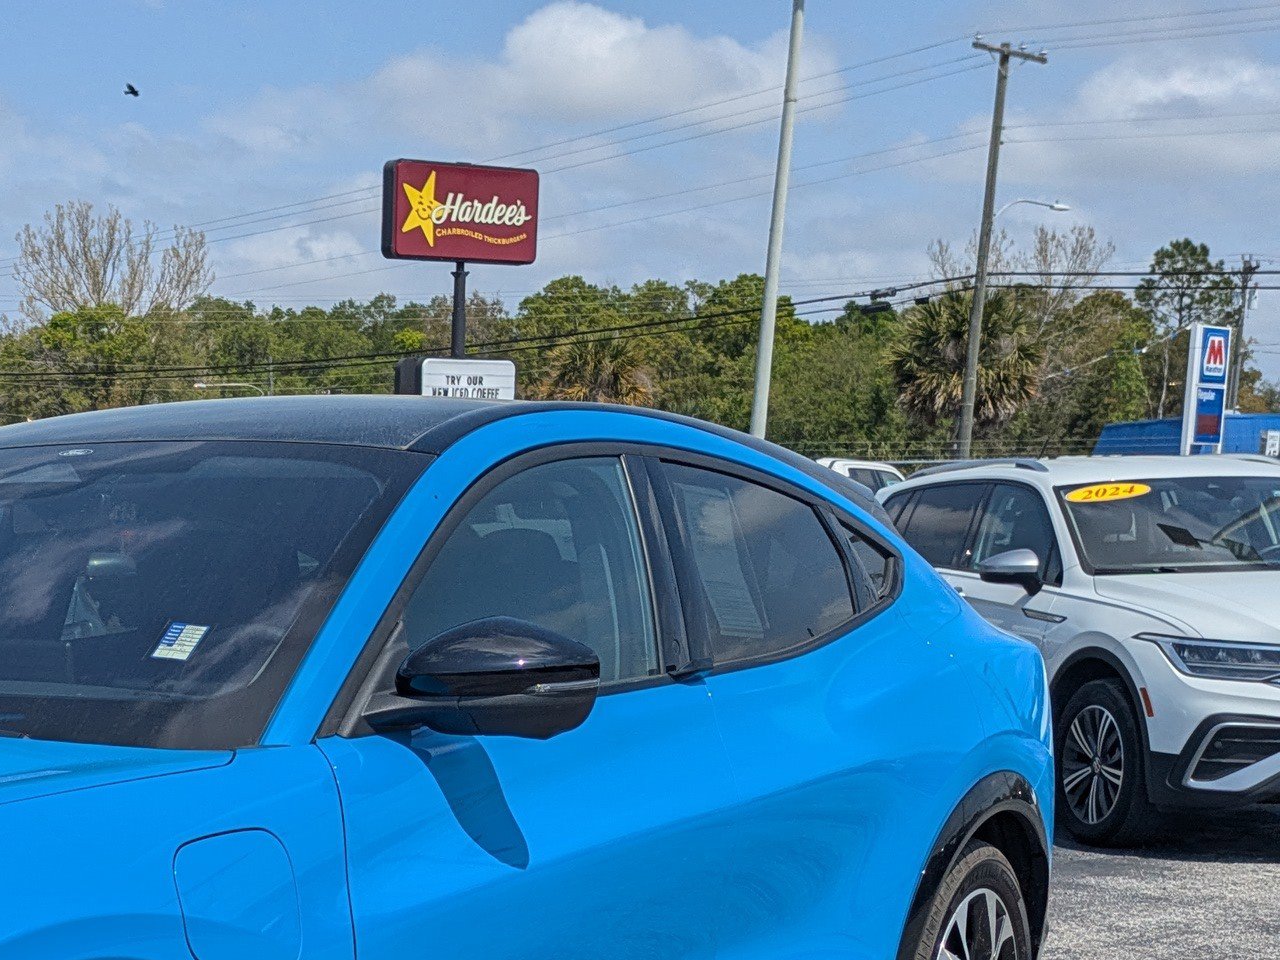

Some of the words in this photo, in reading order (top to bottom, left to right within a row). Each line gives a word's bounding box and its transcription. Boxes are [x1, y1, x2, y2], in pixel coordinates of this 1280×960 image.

[431, 192, 532, 226] Hardee's
[435, 228, 483, 240] CHARBROILED
[484, 233, 527, 245] THICKBURGERS
[445, 375, 462, 385] TRY
[467, 376, 484, 386] OUR
[1081, 485, 1135, 500] 2024
